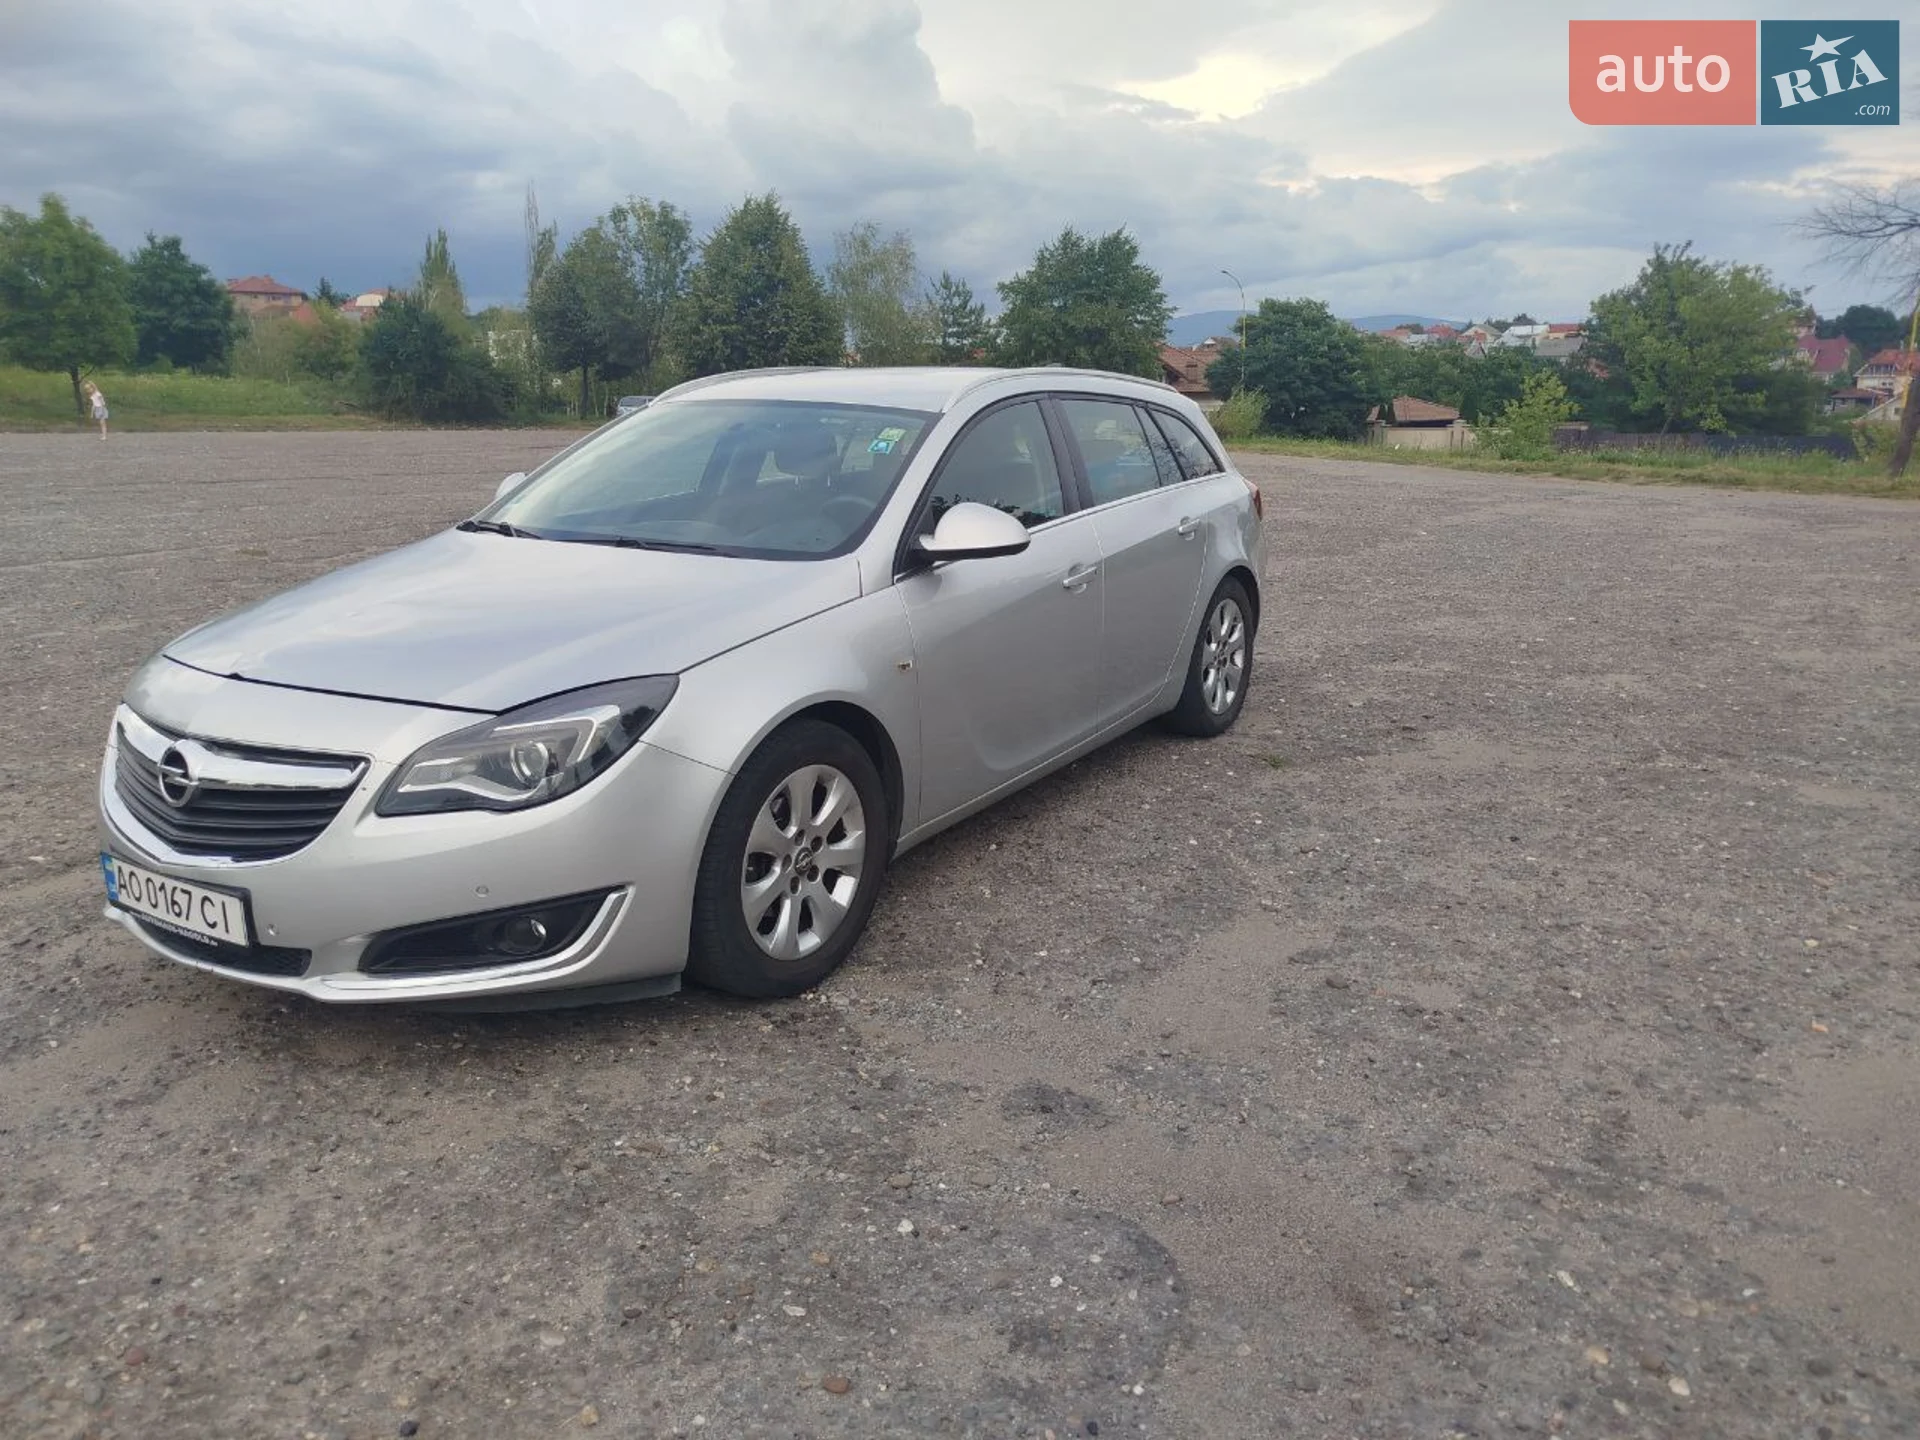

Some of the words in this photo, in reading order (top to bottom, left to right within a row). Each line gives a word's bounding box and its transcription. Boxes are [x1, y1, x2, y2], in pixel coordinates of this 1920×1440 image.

[117, 865, 142, 902] AO
[146, 877, 192, 921] 0167
[201, 895, 230, 934] CI
